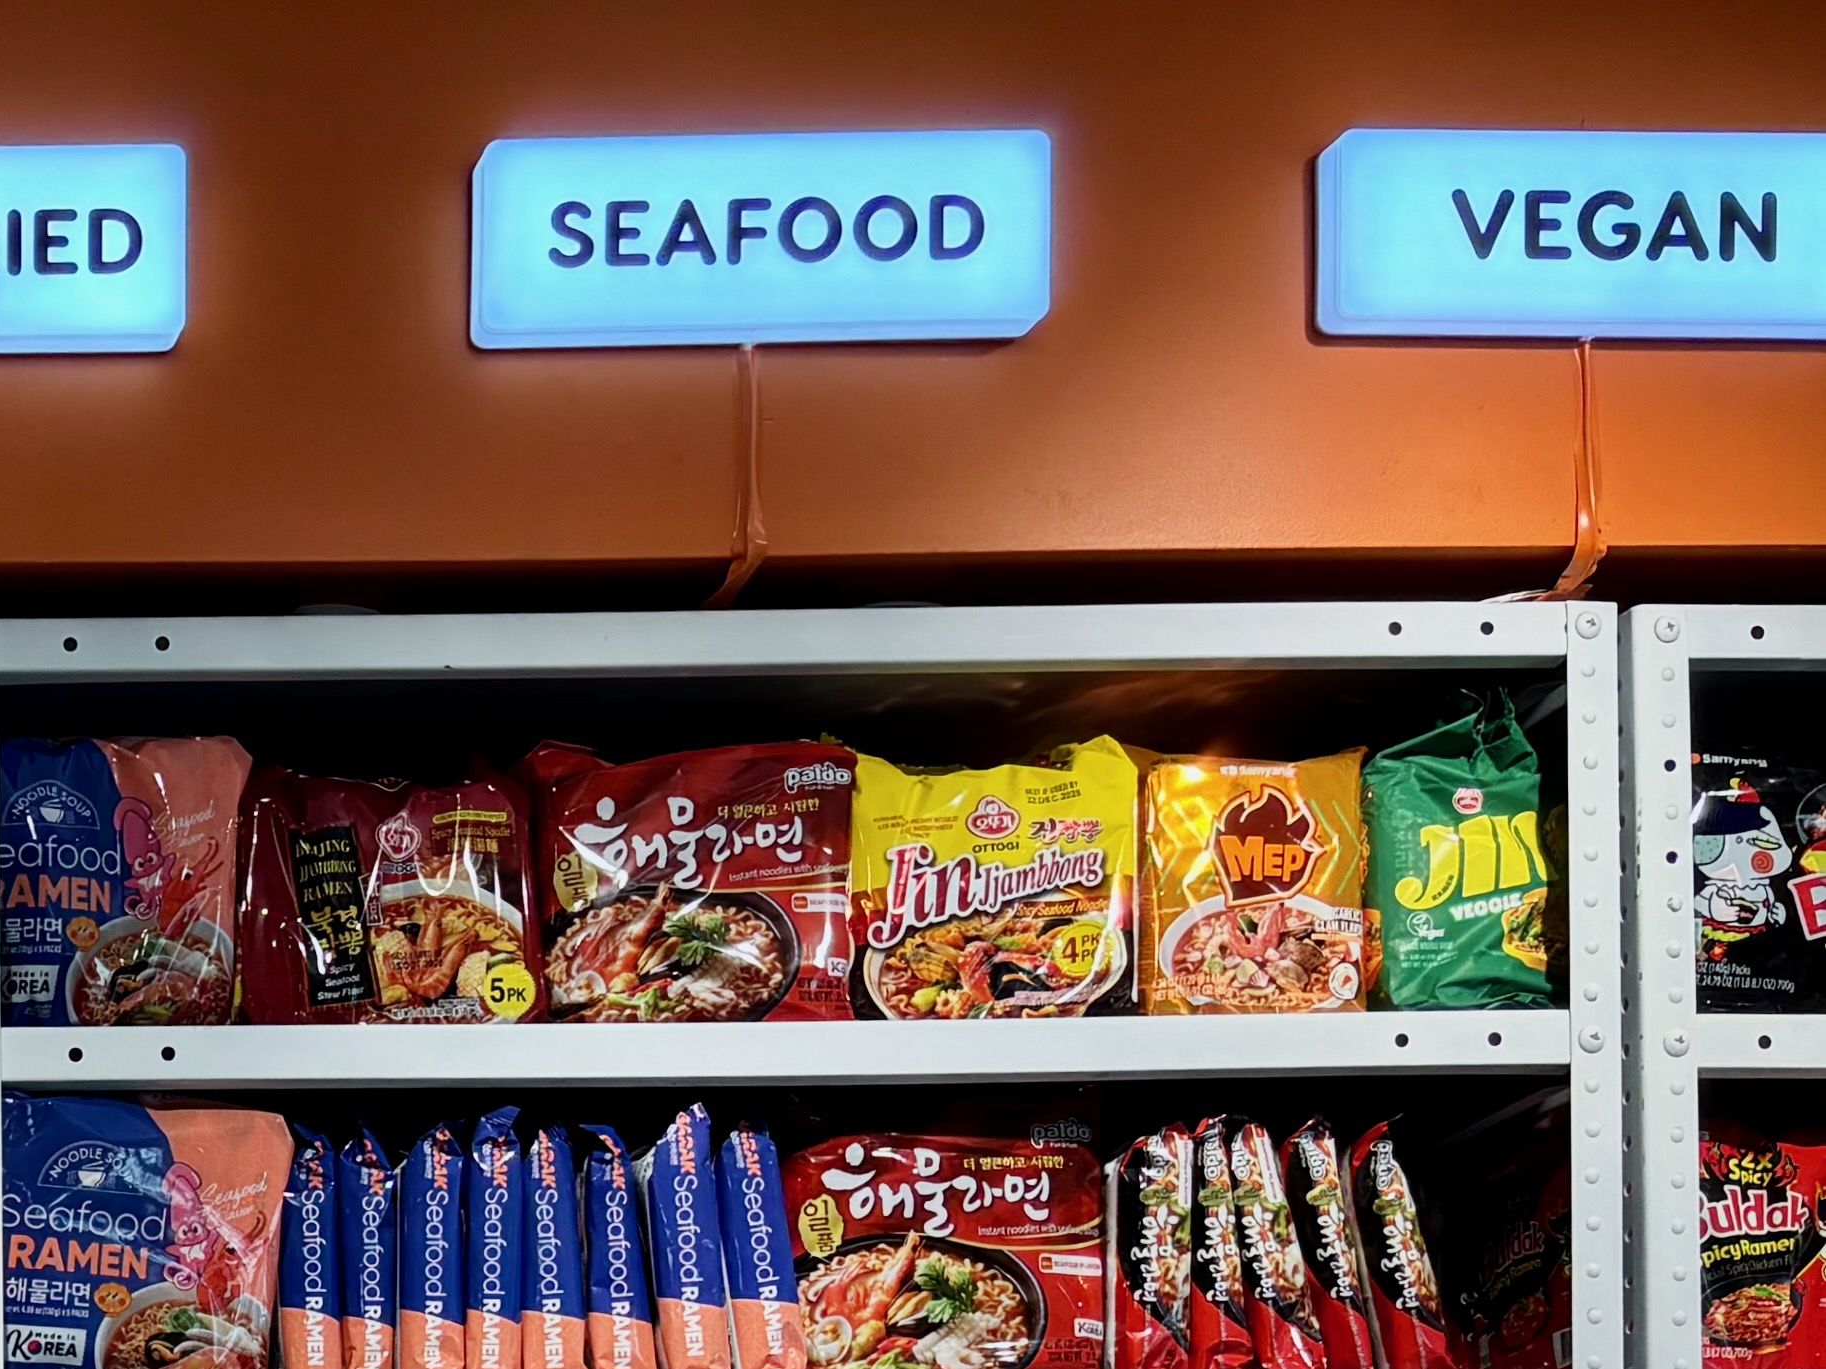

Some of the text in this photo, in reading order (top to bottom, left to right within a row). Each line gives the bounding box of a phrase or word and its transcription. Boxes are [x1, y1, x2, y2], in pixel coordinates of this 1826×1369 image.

[545, 191, 988, 274] SEAFOOD
[1449, 184, 1780, 264] VEGAN
[1221, 830, 1306, 883] MEP
[866, 839, 1105, 951] Jin Jjambbong
[1728, 1162, 1773, 1188] Spicy
[0, 1193, 167, 1243] Seafood
[6, 1233, 150, 1280] RAMEN
[424, 1189, 447, 1369] Seafood RAMEN
[5, 1277, 93, 1309] 해물라면
[10, 1336, 79, 1360] KOREA
